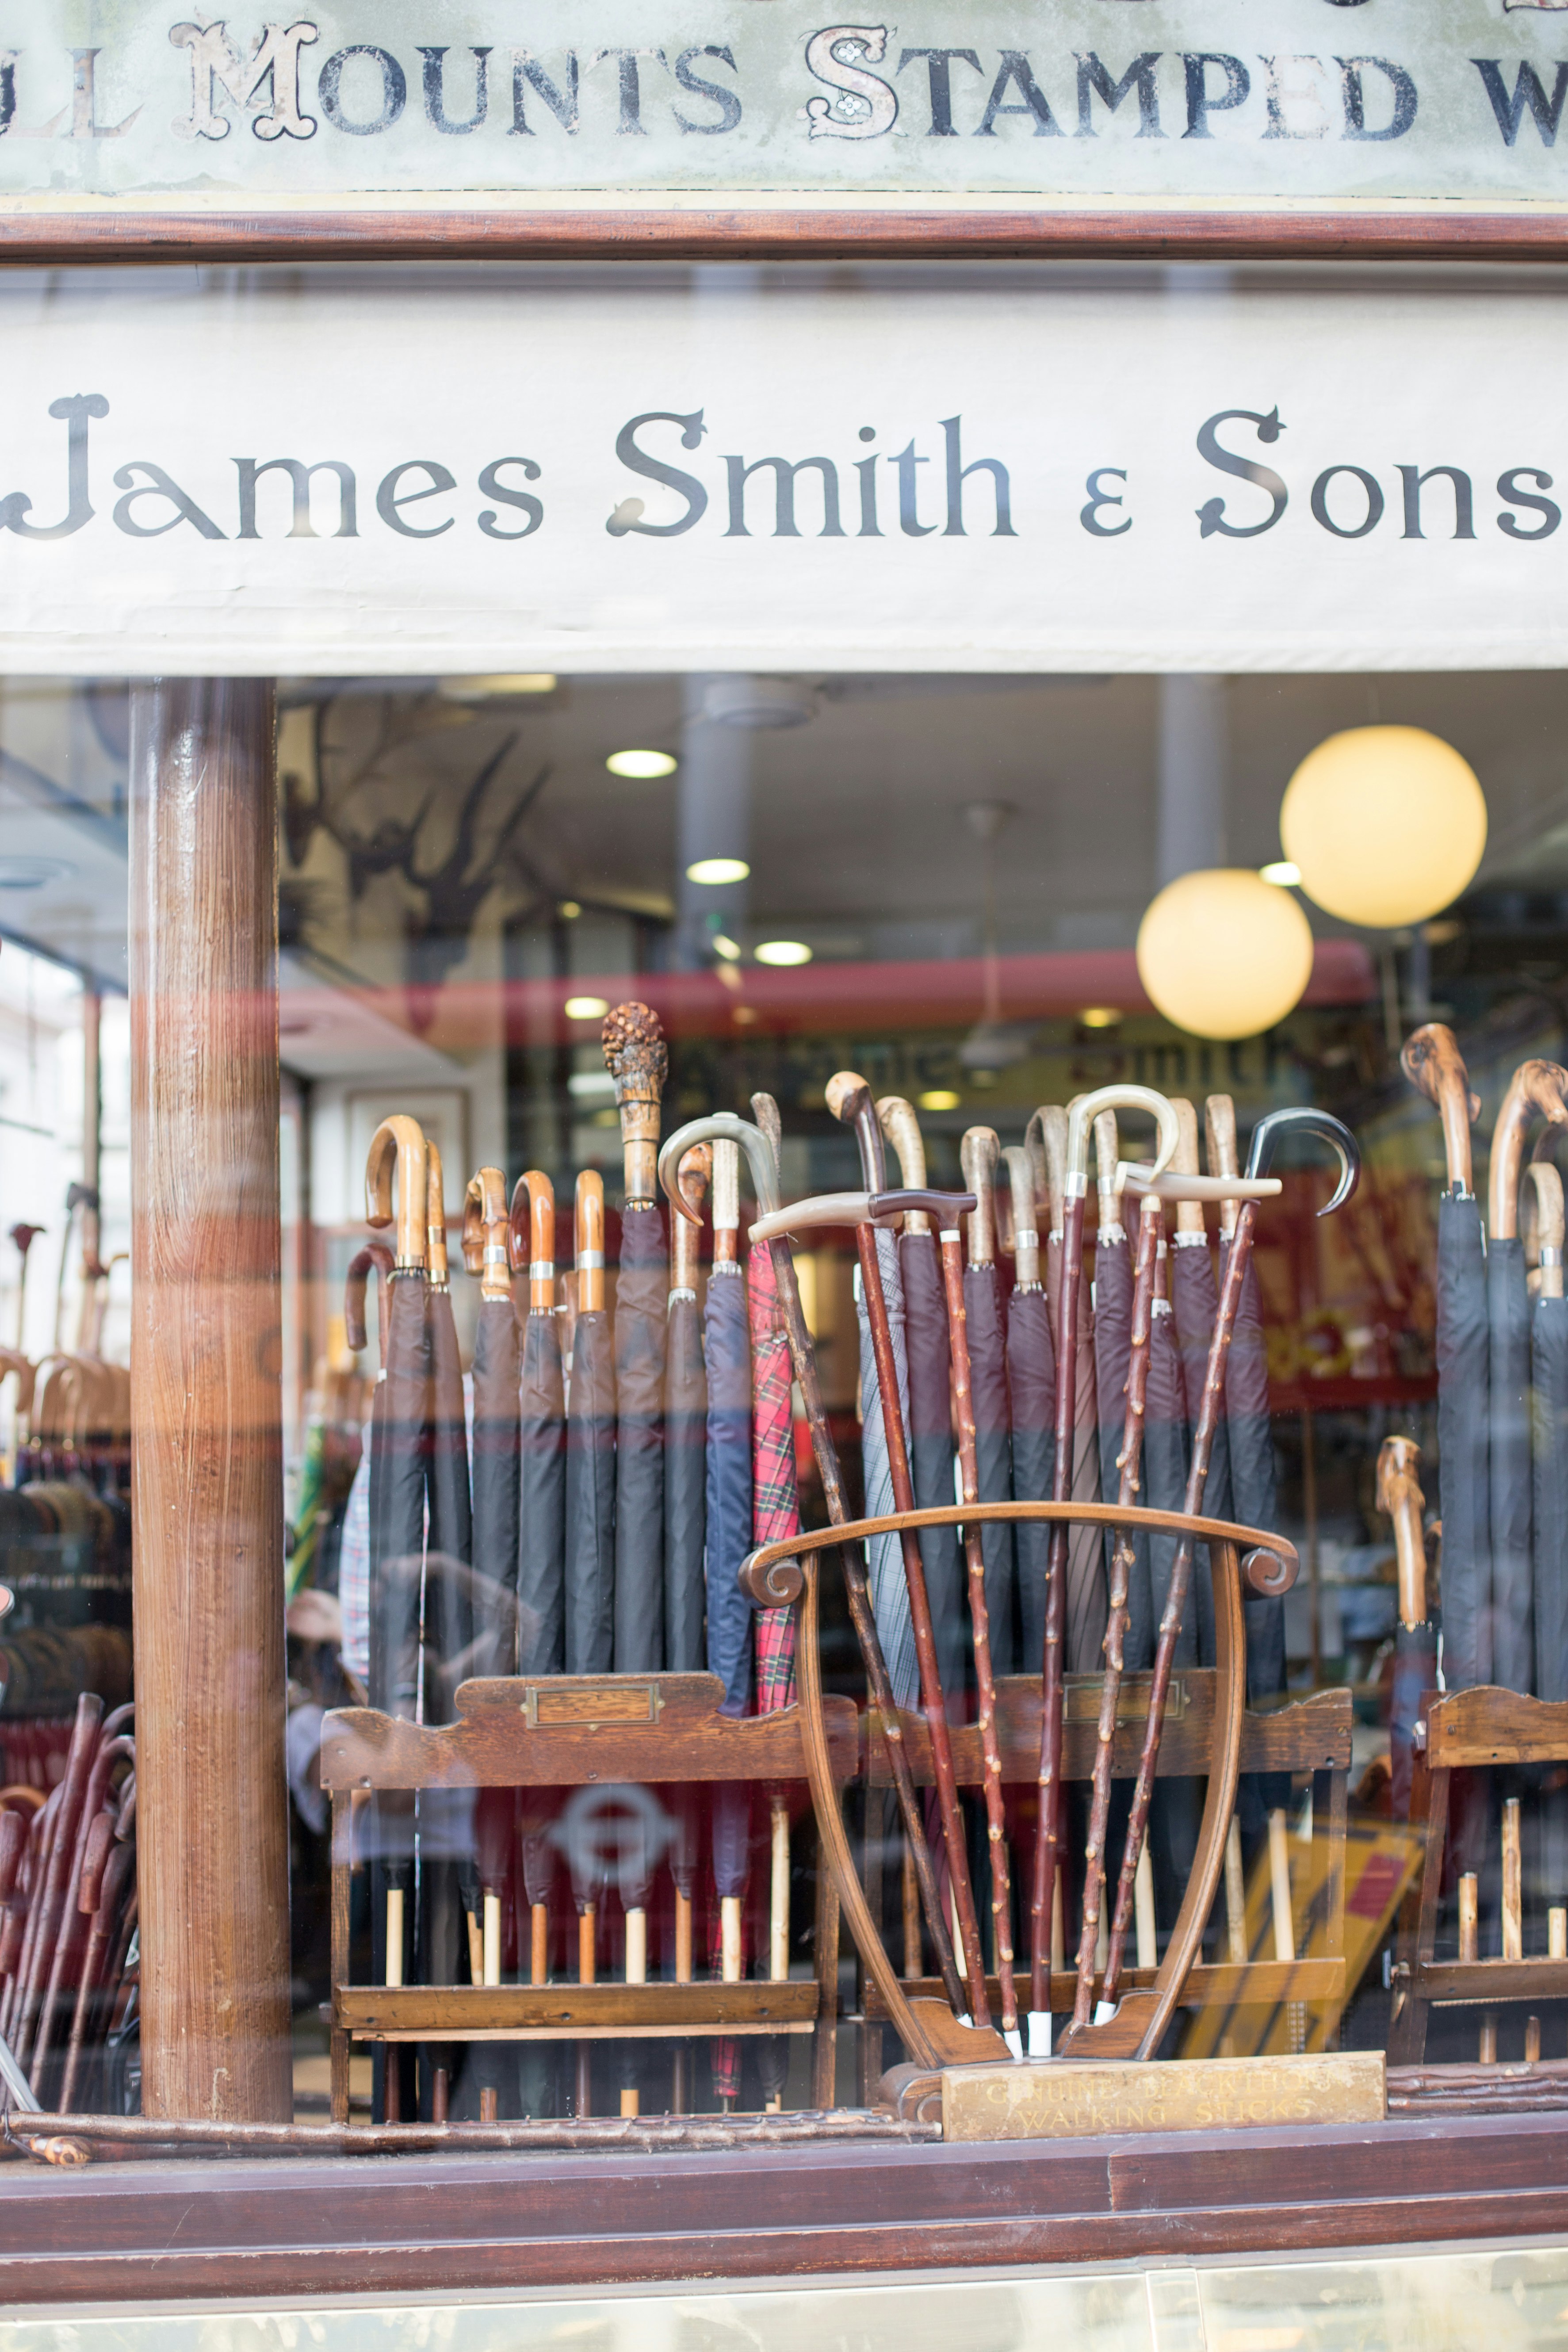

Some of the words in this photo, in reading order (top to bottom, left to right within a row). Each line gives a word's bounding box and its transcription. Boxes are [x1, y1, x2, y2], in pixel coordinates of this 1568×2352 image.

[168, 19, 743, 141] MOUNTS
[806, 24, 1418, 141] STAMPED
[0, 394, 544, 540] James
[606, 408, 1019, 537] Smith
[1195, 405, 1561, 540] Sons
[986, 2077, 1113, 2105] GENUINE
[1144, 2069, 1343, 2097] BLACKTHORN
[1015, 2105, 1166, 2130] WALKING
[1196, 2098, 1310, 2123] STICKS
